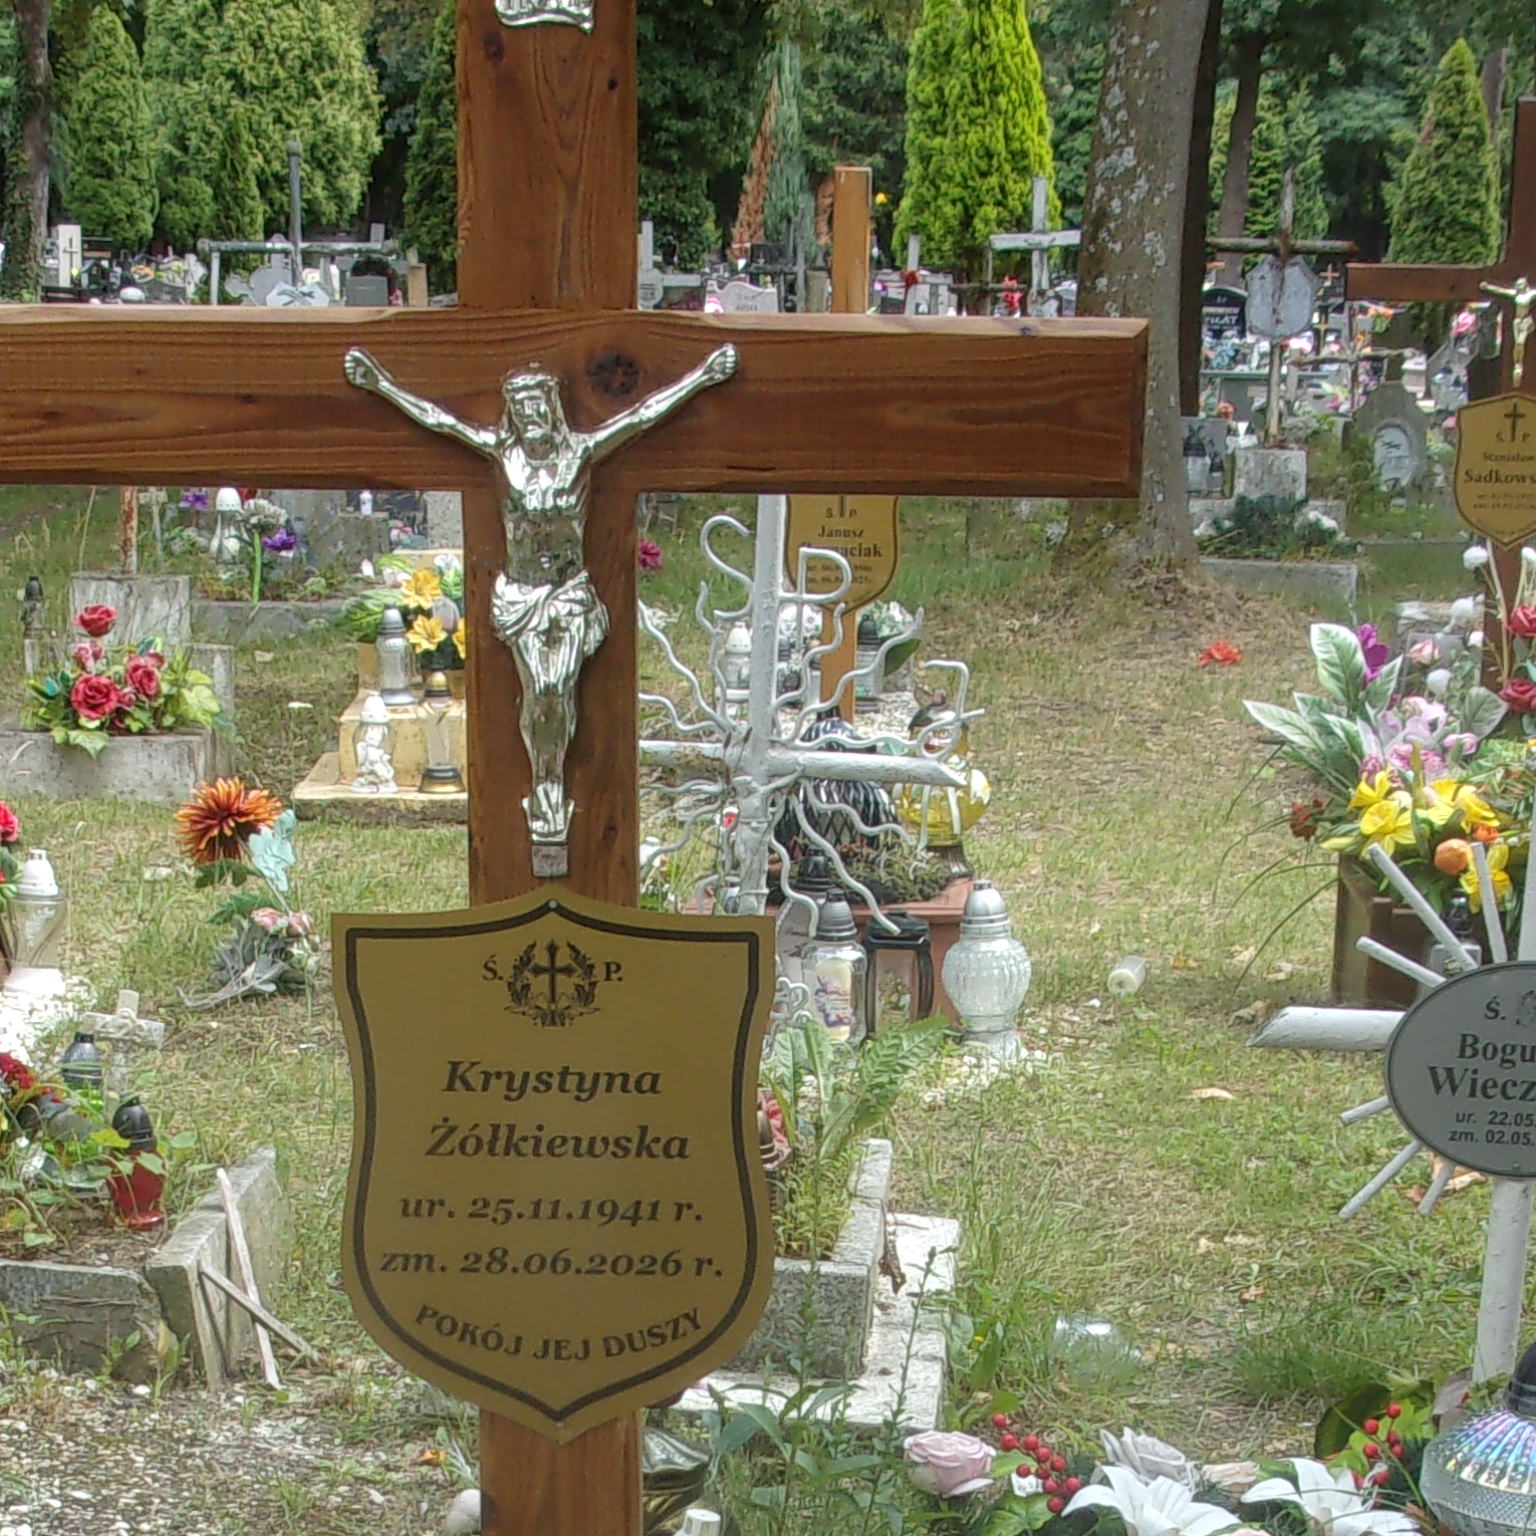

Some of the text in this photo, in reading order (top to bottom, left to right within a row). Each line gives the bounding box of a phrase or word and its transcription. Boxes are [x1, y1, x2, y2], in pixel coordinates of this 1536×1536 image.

[818, 525, 865, 539] Janusz
[483, 954, 624, 983] Ś. P.
[442, 1060, 662, 1102] Krystyna
[1455, 1110, 1477, 1124] ur.
[425, 1116, 691, 1160] Żółkiewska
[1448, 1130, 1478, 1144] zm.
[400, 1197, 703, 1226] ur. 25.11.1941 r.
[380, 1246, 724, 1278] zm. 28.06.2026 r.
[416, 1304, 704, 1361] POKÓJ JEJ DUSZY
